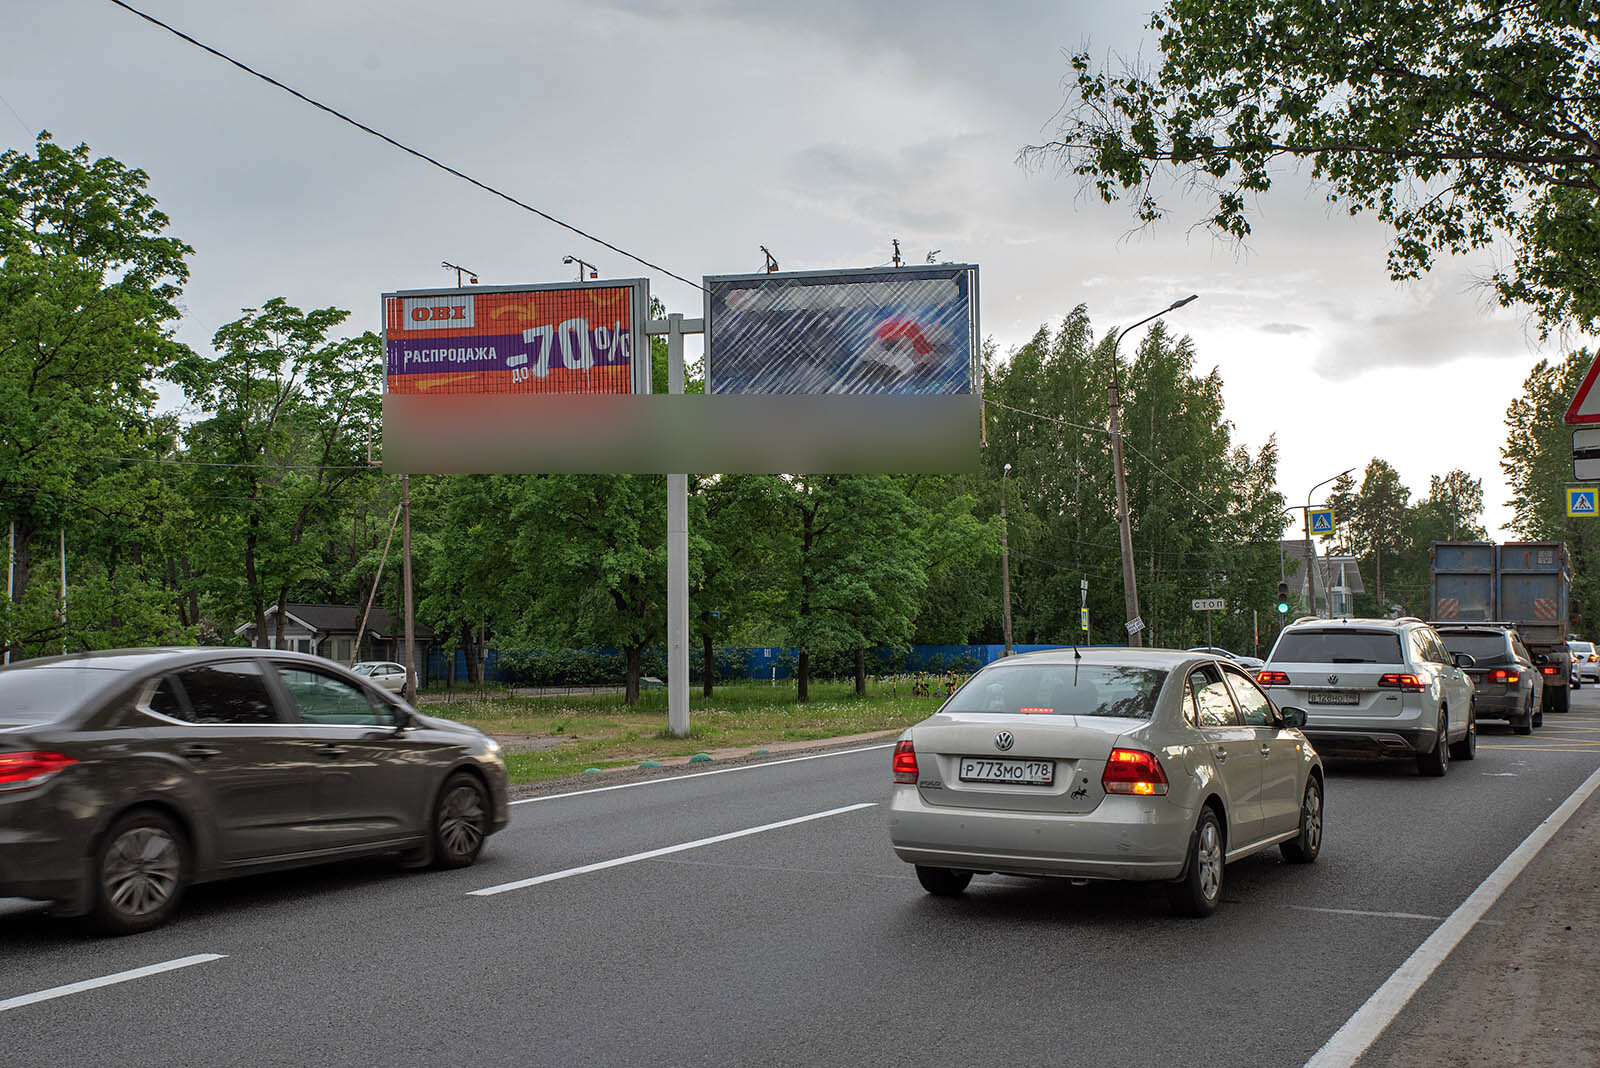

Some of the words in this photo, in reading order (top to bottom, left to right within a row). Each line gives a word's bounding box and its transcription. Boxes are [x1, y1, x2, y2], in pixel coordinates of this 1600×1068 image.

[411, 305, 466, 322] OBI
[403, 347, 497, 364] РАСПРОДАЖА
[1194, 601, 1223, 609] СТОП
[1027, 764, 1048, 776] 178
